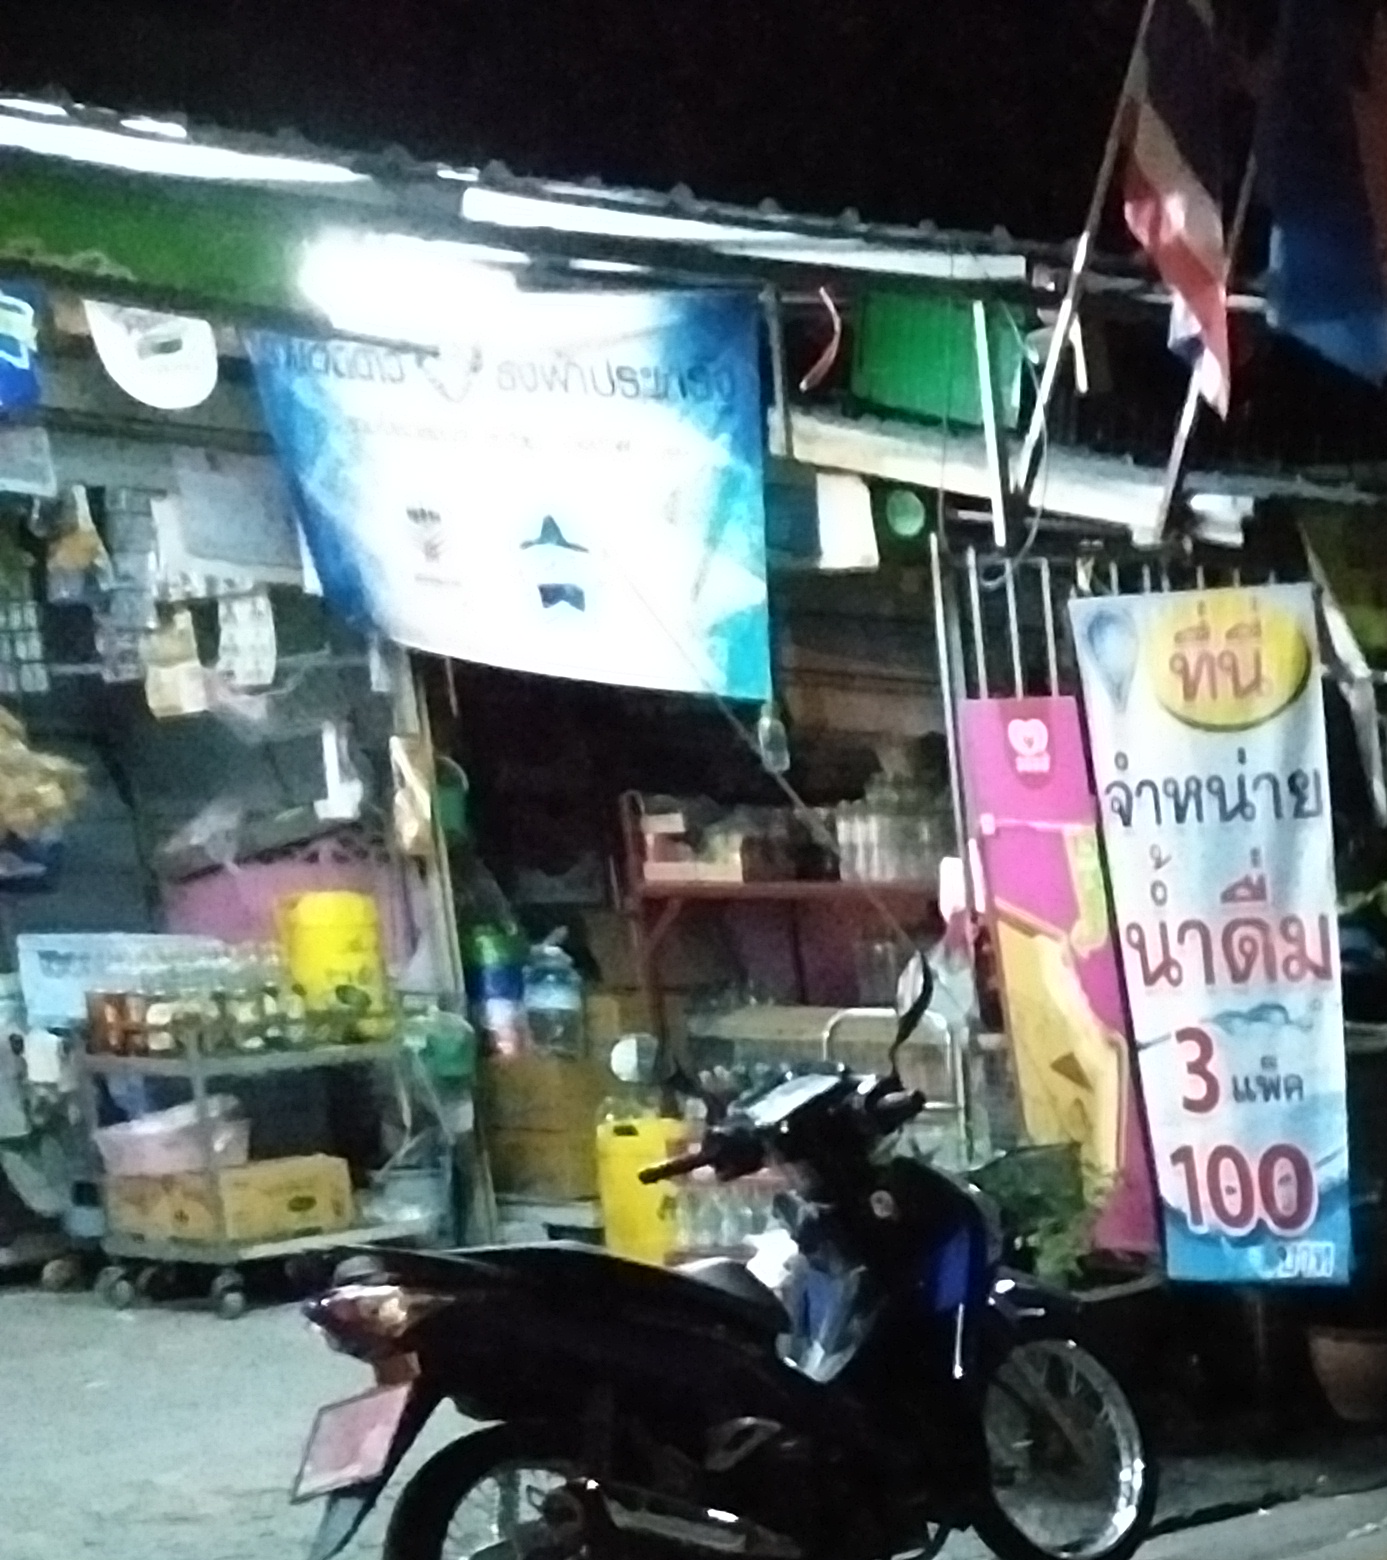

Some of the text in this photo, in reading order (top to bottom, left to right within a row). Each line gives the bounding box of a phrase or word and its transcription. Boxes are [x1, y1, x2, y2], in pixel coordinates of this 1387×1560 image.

[1170, 597, 1270, 702] ที่นี่
[1104, 747, 1324, 827] จำหน่าย
[1126, 843, 1333, 988] น้ำดื่ม
[1173, 1027, 1304, 1114] 3 แพ็ค
[1171, 1142, 1318, 1236] 100
